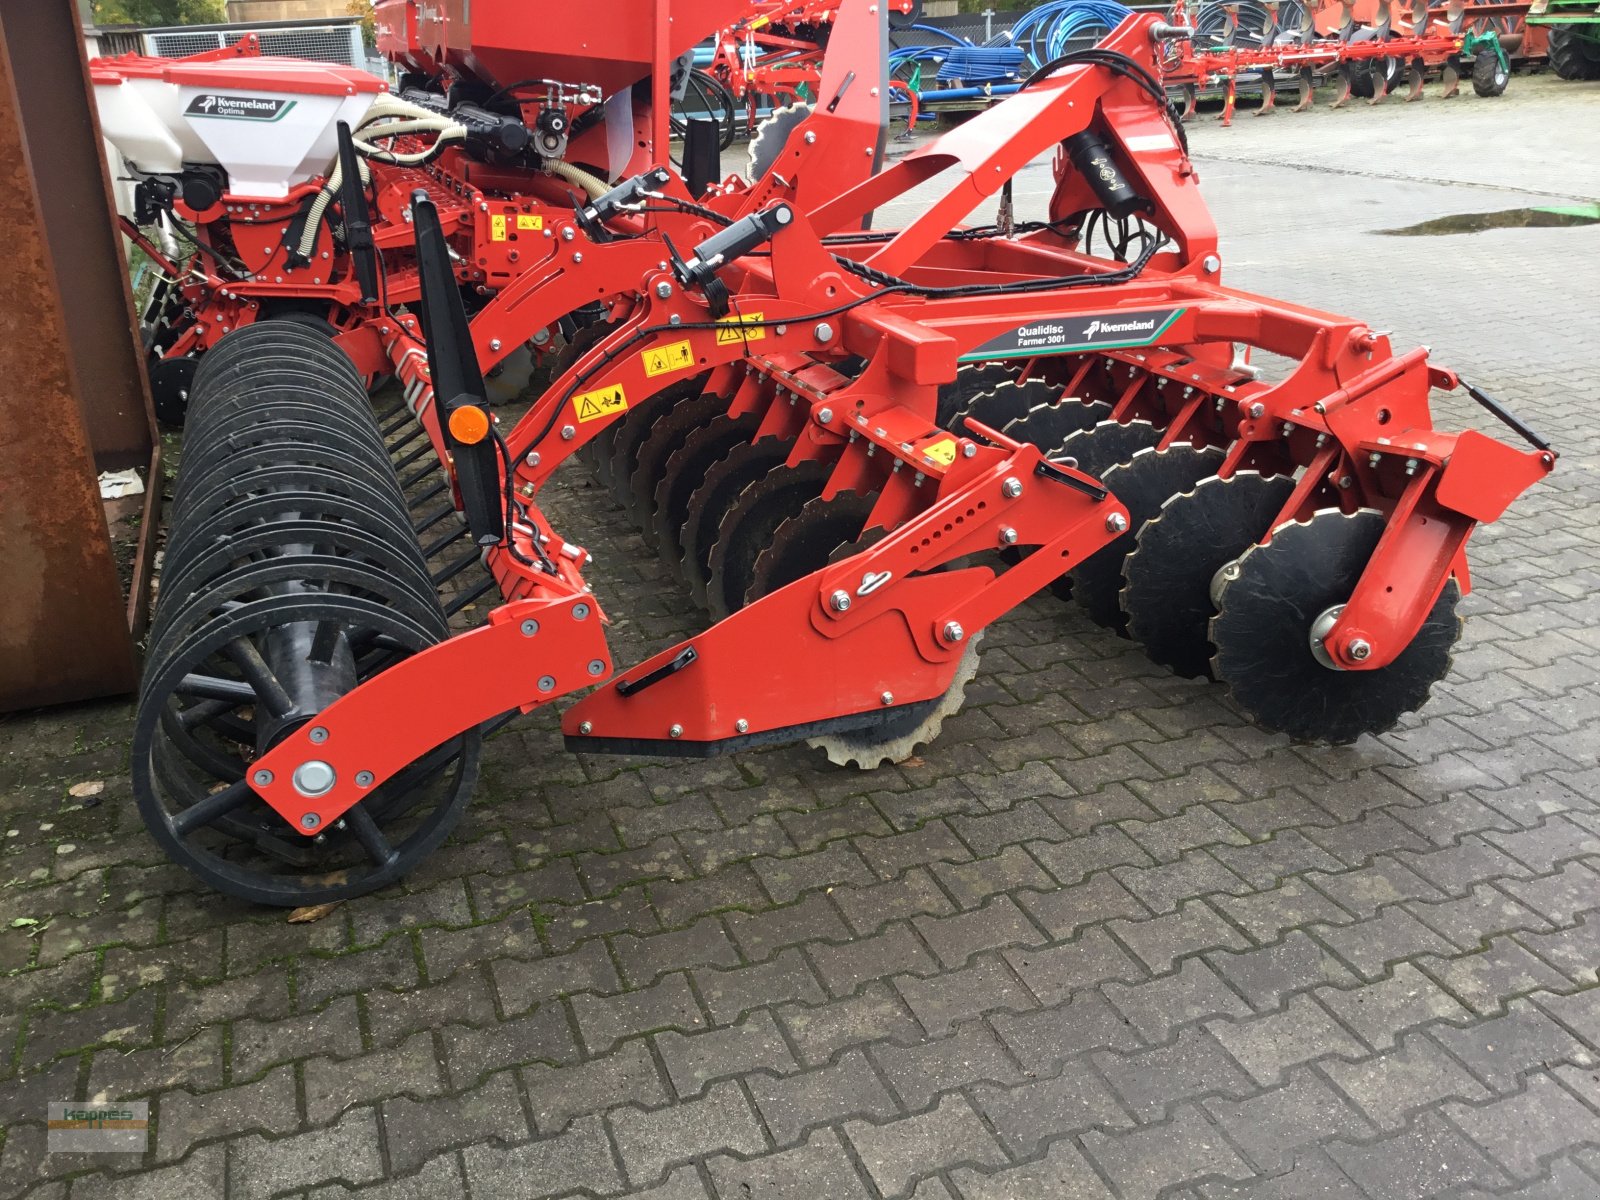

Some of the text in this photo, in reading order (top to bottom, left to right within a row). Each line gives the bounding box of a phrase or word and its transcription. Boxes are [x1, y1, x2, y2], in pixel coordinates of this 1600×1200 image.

[217, 97, 276, 110] Kverneland
[217, 106, 245, 115] Optima
[1017, 325, 1064, 337] Qualidisc
[1100, 319, 1154, 333] Kverneland
[1017, 335, 1066, 346] Farmer 3001
